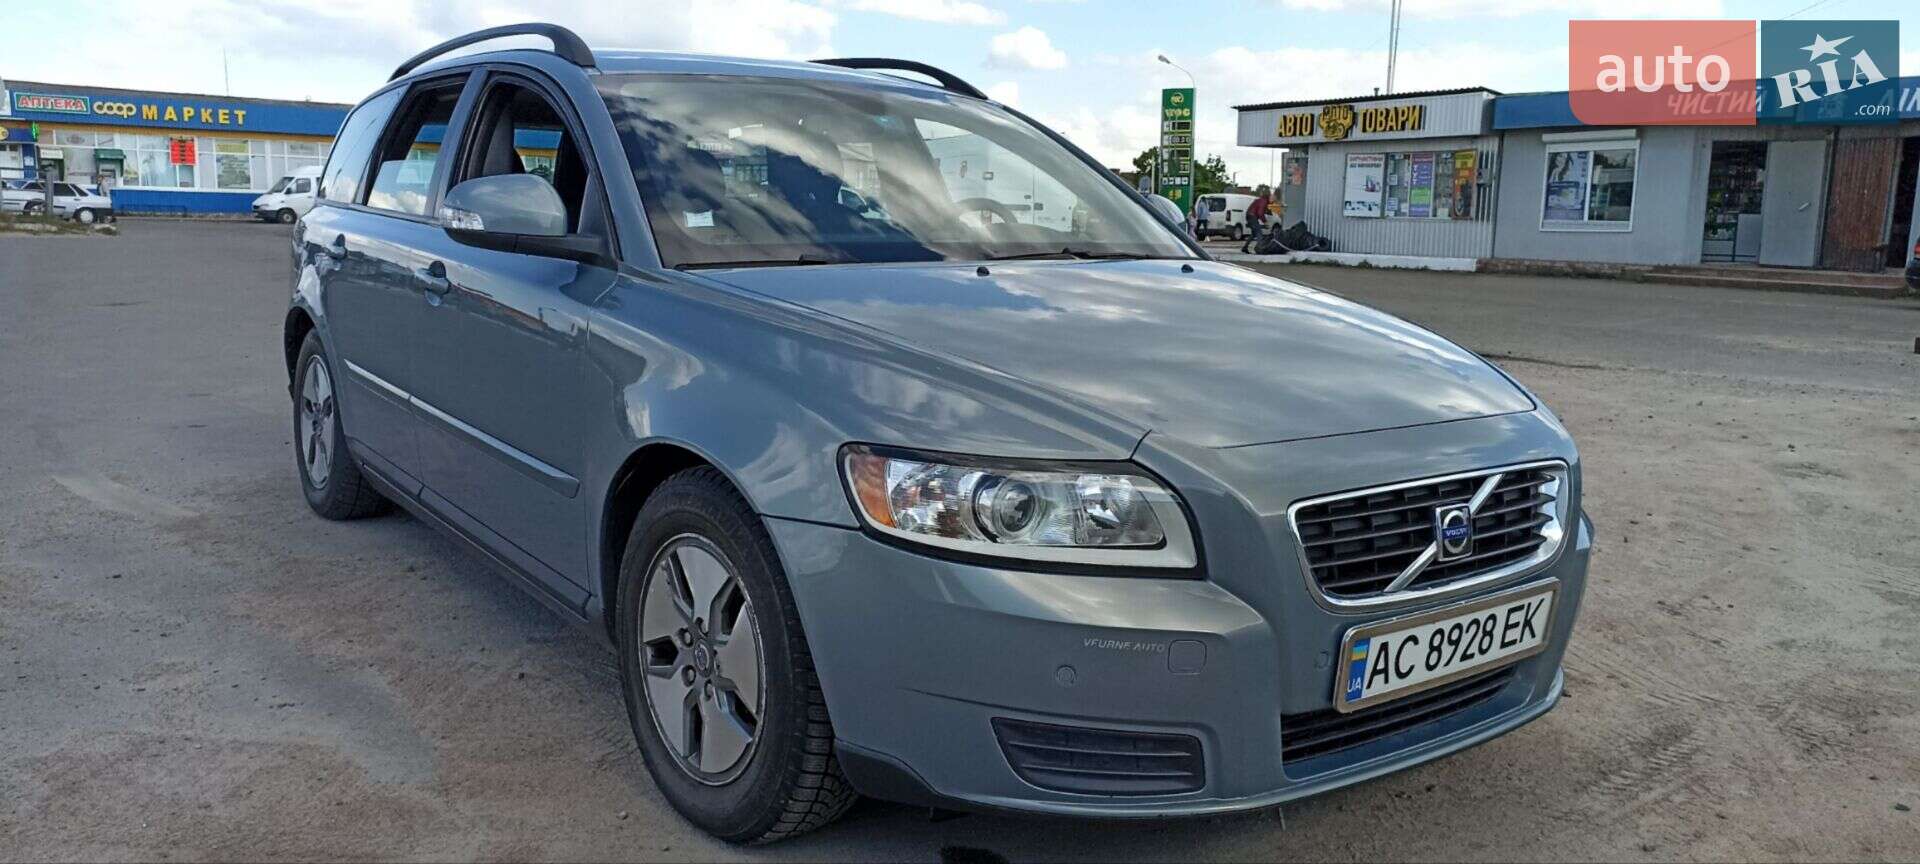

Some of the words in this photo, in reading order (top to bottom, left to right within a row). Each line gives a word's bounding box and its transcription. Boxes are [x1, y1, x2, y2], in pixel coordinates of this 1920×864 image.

[19, 95, 87, 112] АПТЕКА
[142, 104, 246, 125] МАРКЕТ
[1278, 113, 1313, 137] АВТО
[1360, 105, 1422, 132] ТОВАРИ
[1366, 634, 1419, 689] AC
[1425, 613, 1497, 671] 8928
[1500, 598, 1545, 649] EK
[1347, 676, 1362, 693] UA
